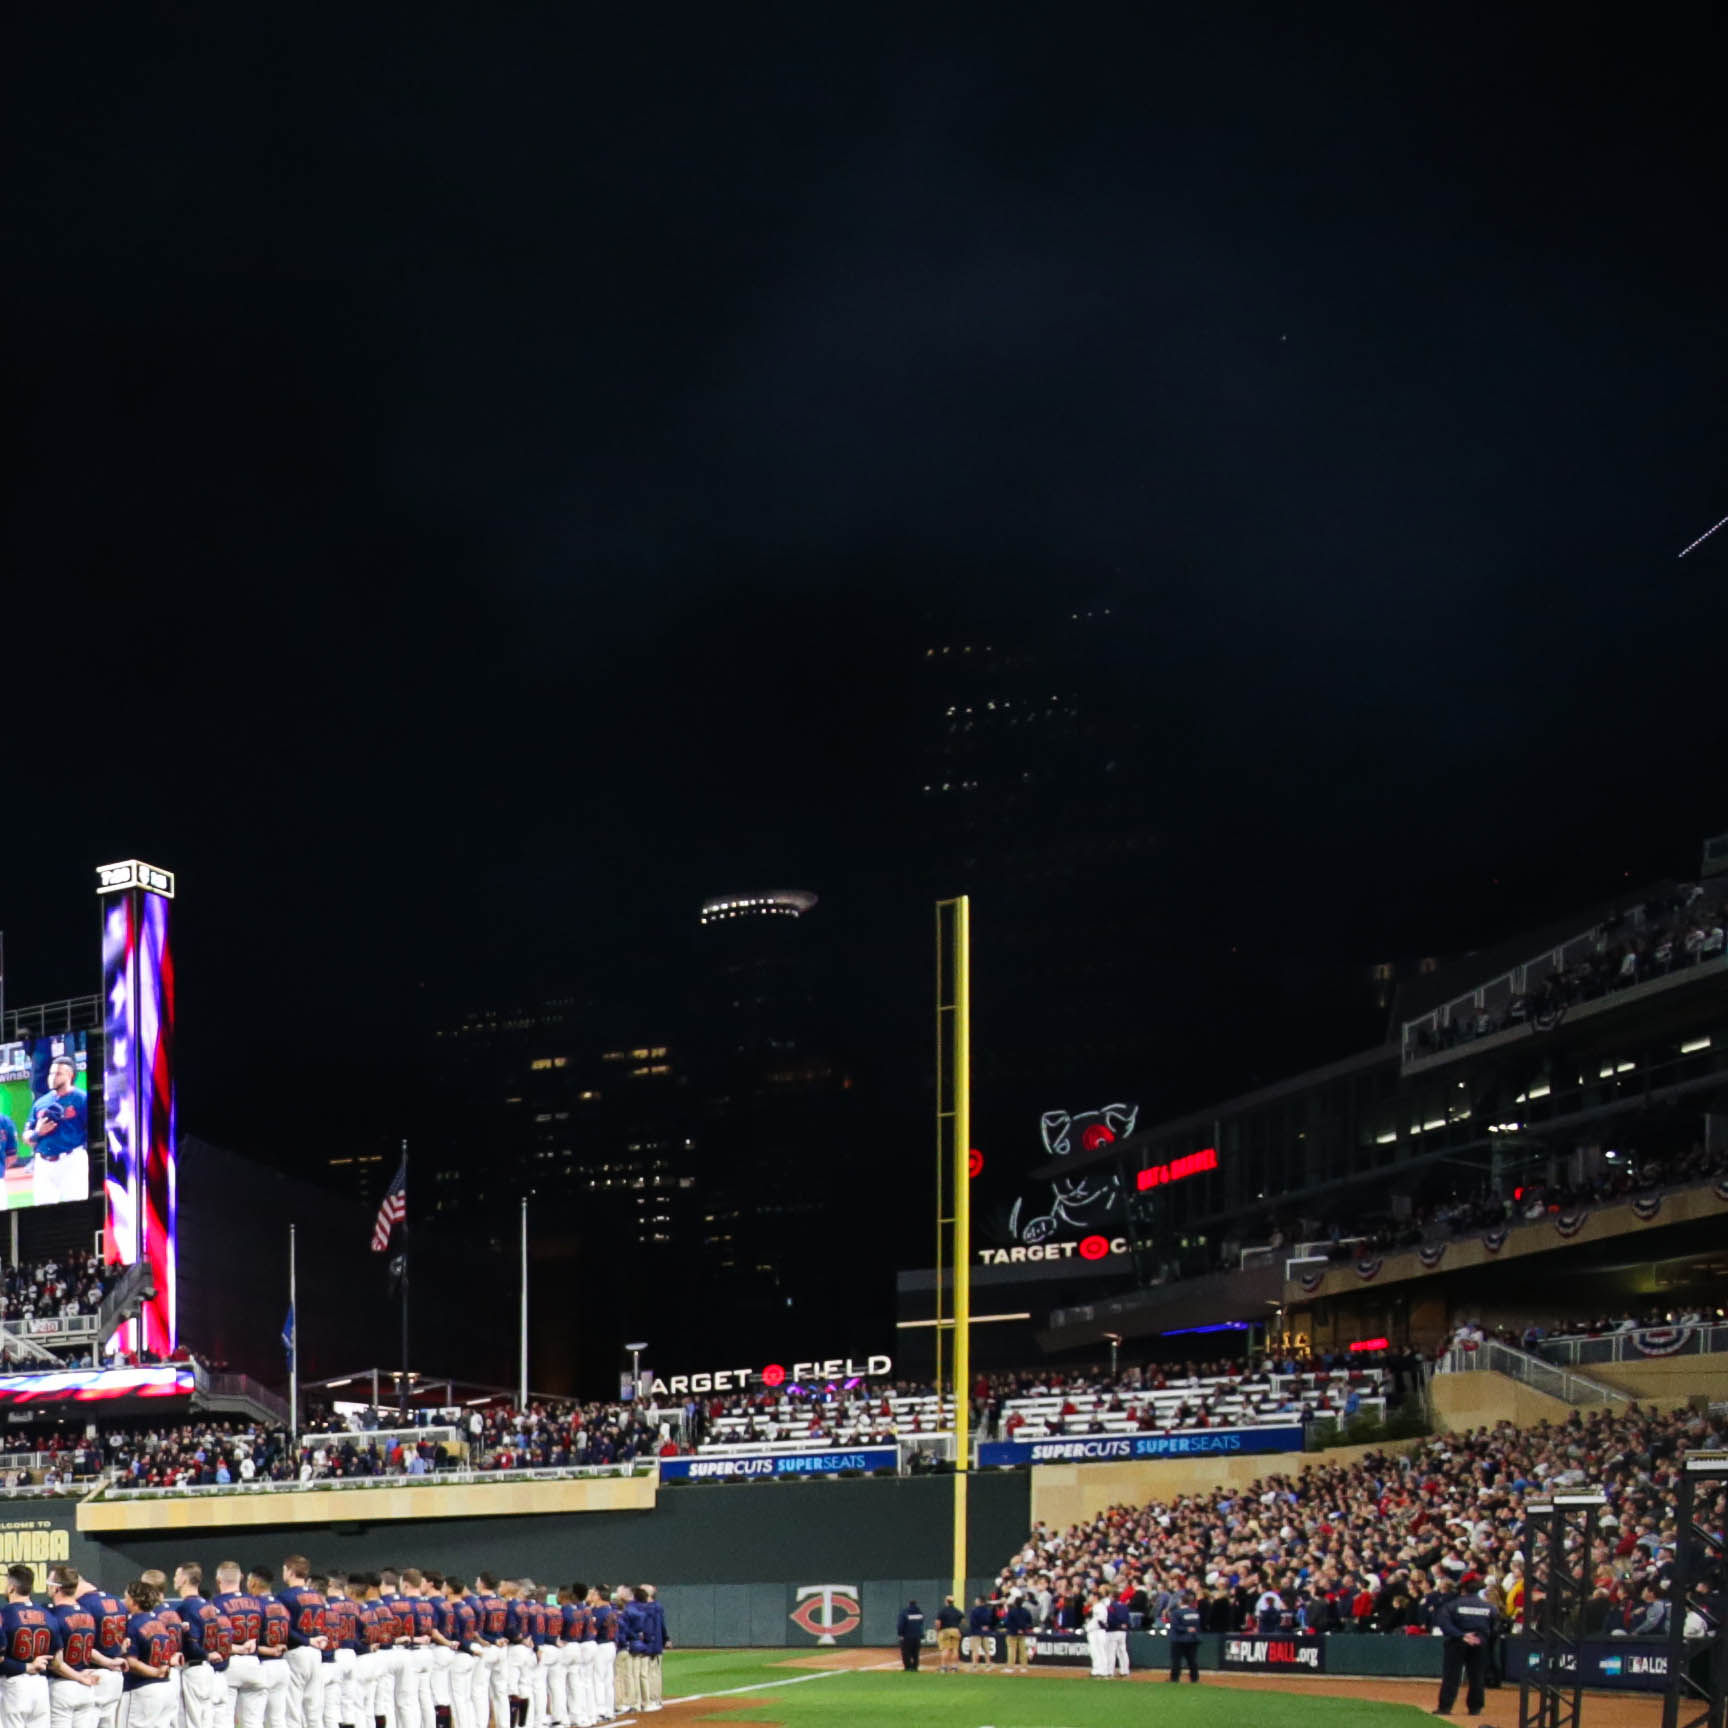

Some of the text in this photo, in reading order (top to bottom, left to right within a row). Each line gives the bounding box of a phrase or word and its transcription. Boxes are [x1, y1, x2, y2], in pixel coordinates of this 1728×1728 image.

[978, 1241, 1078, 1265] TARGET
[638, 1355, 893, 1395] ARGET FIELD
[1031, 1434, 1241, 1460] SUPERCUTS SUPERSEATS
[688, 1454, 866, 1477] SUPERCUTS SUPERSEATS
[37, 1520, 52, 1528] TO
[230, 1614, 262, 1643] 52
[298, 1607, 327, 1635] 44
[13, 1626, 51, 1660] 60
[1240, 1640, 1319, 1668] PLAYBALL.org
